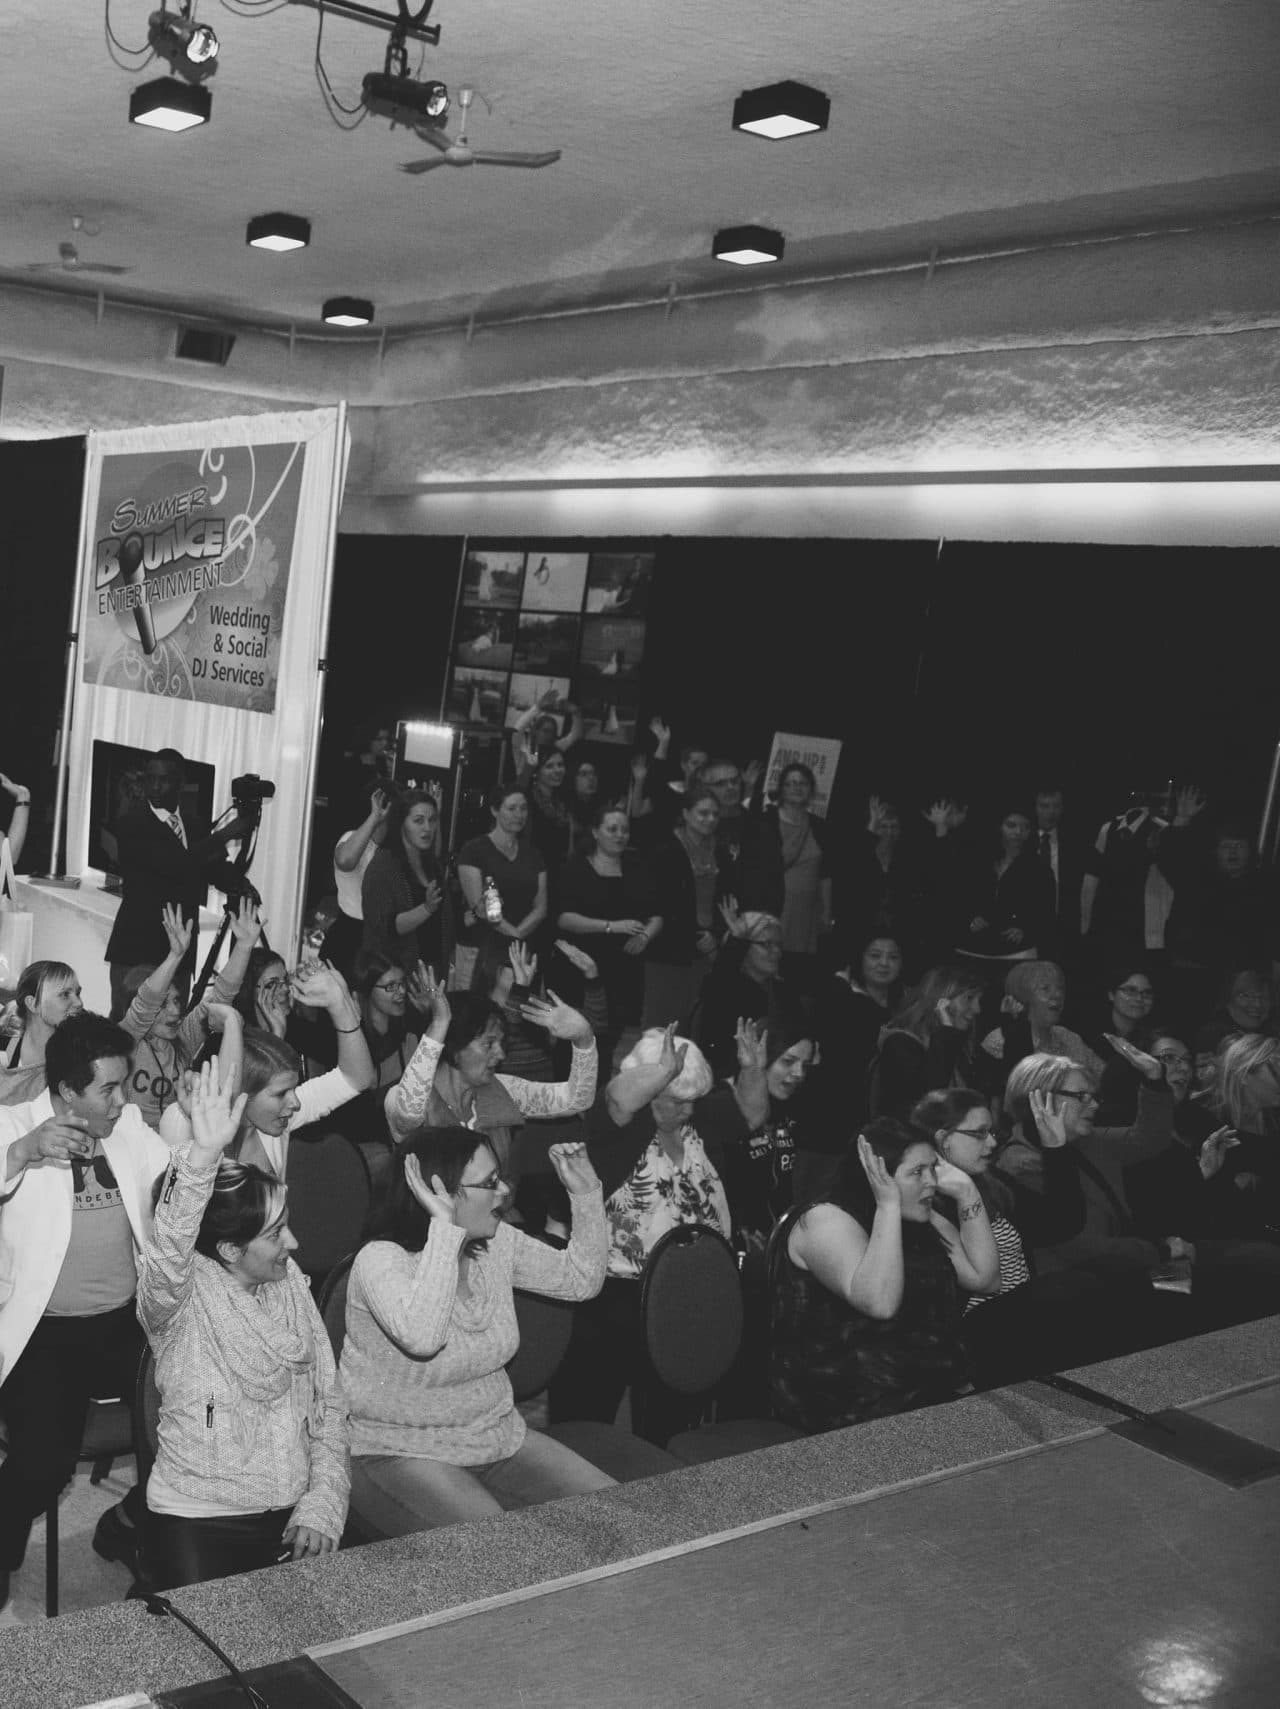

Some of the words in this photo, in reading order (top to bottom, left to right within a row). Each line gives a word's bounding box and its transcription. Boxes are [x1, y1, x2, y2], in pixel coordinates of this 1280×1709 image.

[110, 486, 208, 533] SUMMER
[95, 514, 226, 592] BOUNCE
[98, 561, 224, 616] ENTERTAINMENT
[209, 604, 271, 635] Wedding
[213, 634, 224, 653] &
[227, 634, 269, 659] Social
[191, 657, 208, 679] DJ
[211, 659, 265, 687] Services
